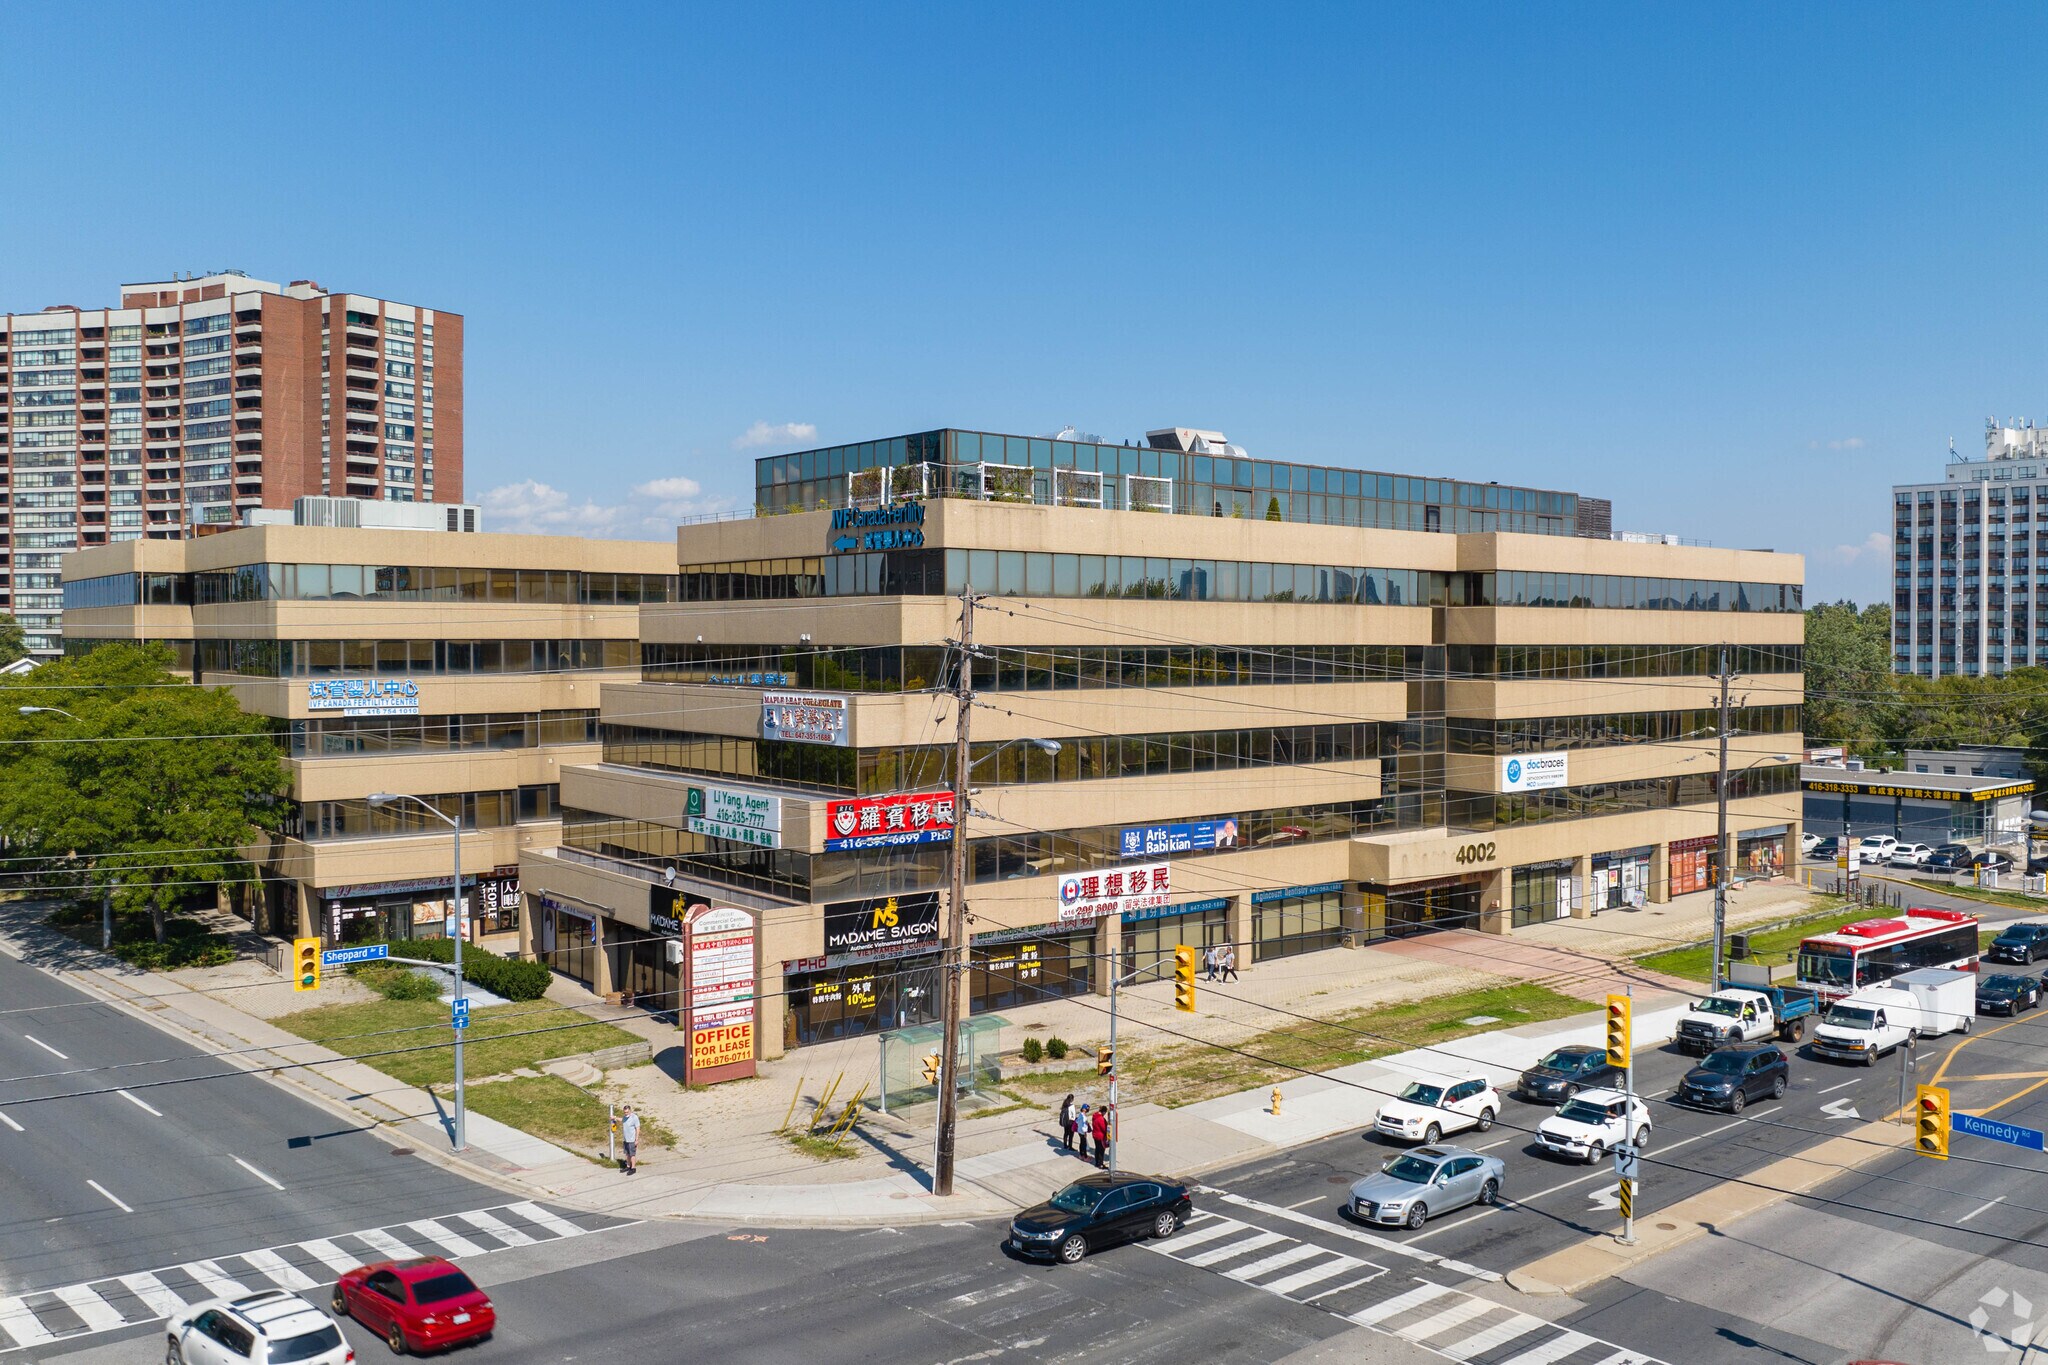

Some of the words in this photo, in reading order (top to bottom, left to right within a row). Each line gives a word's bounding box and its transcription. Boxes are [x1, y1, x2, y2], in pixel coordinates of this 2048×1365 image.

[831, 508, 850, 529] IVF
[852, 503, 887, 528] Canada
[888, 501, 925, 526] Fertility
[308, 679, 419, 698] 试管婴儿中心
[309, 699, 321, 708] IVF
[323, 699, 352, 707] CANADA
[354, 698, 389, 706] FERTILITY
[391, 697, 418, 705] CENTRE
[764, 696, 785, 704] MAPLE
[786, 697, 801, 705] LEAF
[802, 697, 843, 708] COLLEGIATE
[1527, 758, 1564, 769] docbraces
[1809, 782, 1858, 794] 416-318-3333
[714, 790, 721, 803] Li
[722, 791, 743, 809] Yang,
[745, 795, 769, 811] Agent
[716, 808, 765, 827] 416-335-7777
[859, 800, 954, 831] 羅賓移民
[1146, 828, 1167, 841] Aris
[1146, 838, 1191, 854] Babikian
[1456, 842, 1496, 865] 4002
[1081, 867, 1170, 899] 理想移民
[487, 880, 498, 919] PEOPLE
[1124, 894, 1171, 910] 留学法律集团
[1256, 890, 1283, 902] Agincourt
[1285, 886, 1308, 897] Dentistry
[651, 913, 678, 931] MADAME
[699, 918, 728, 926] Commercial
[829, 928, 886, 947] MADAME
[891, 921, 938, 938] SAIGON
[977, 930, 995, 940] BEEF
[997, 926, 1026, 937] NOODLE
[1027, 923, 1046, 933] SOUP
[850, 943, 873, 951] Authentic
[874, 940, 902, 949] Vietnamese
[902, 937, 918, 945] Eatery
[857, 945, 904, 957] VIETNAMESE
[908, 940, 938, 950] CUISINE
[1022, 945, 1036, 953] Bun
[326, 948, 368, 962] Sheppard
[378, 946, 384, 956] E
[454, 1001, 467, 1015] H
[846, 993, 867, 1006] 10%
[695, 1025, 751, 1044] OFFICE
[695, 1045, 716, 1057] FOR
[719, 1039, 750, 1053] LEASE
[695, 1050, 751, 1067] 416-876-0711
[1964, 1116, 2019, 1143] Kennedy
[2021, 1129, 2031, 1138] Rd
